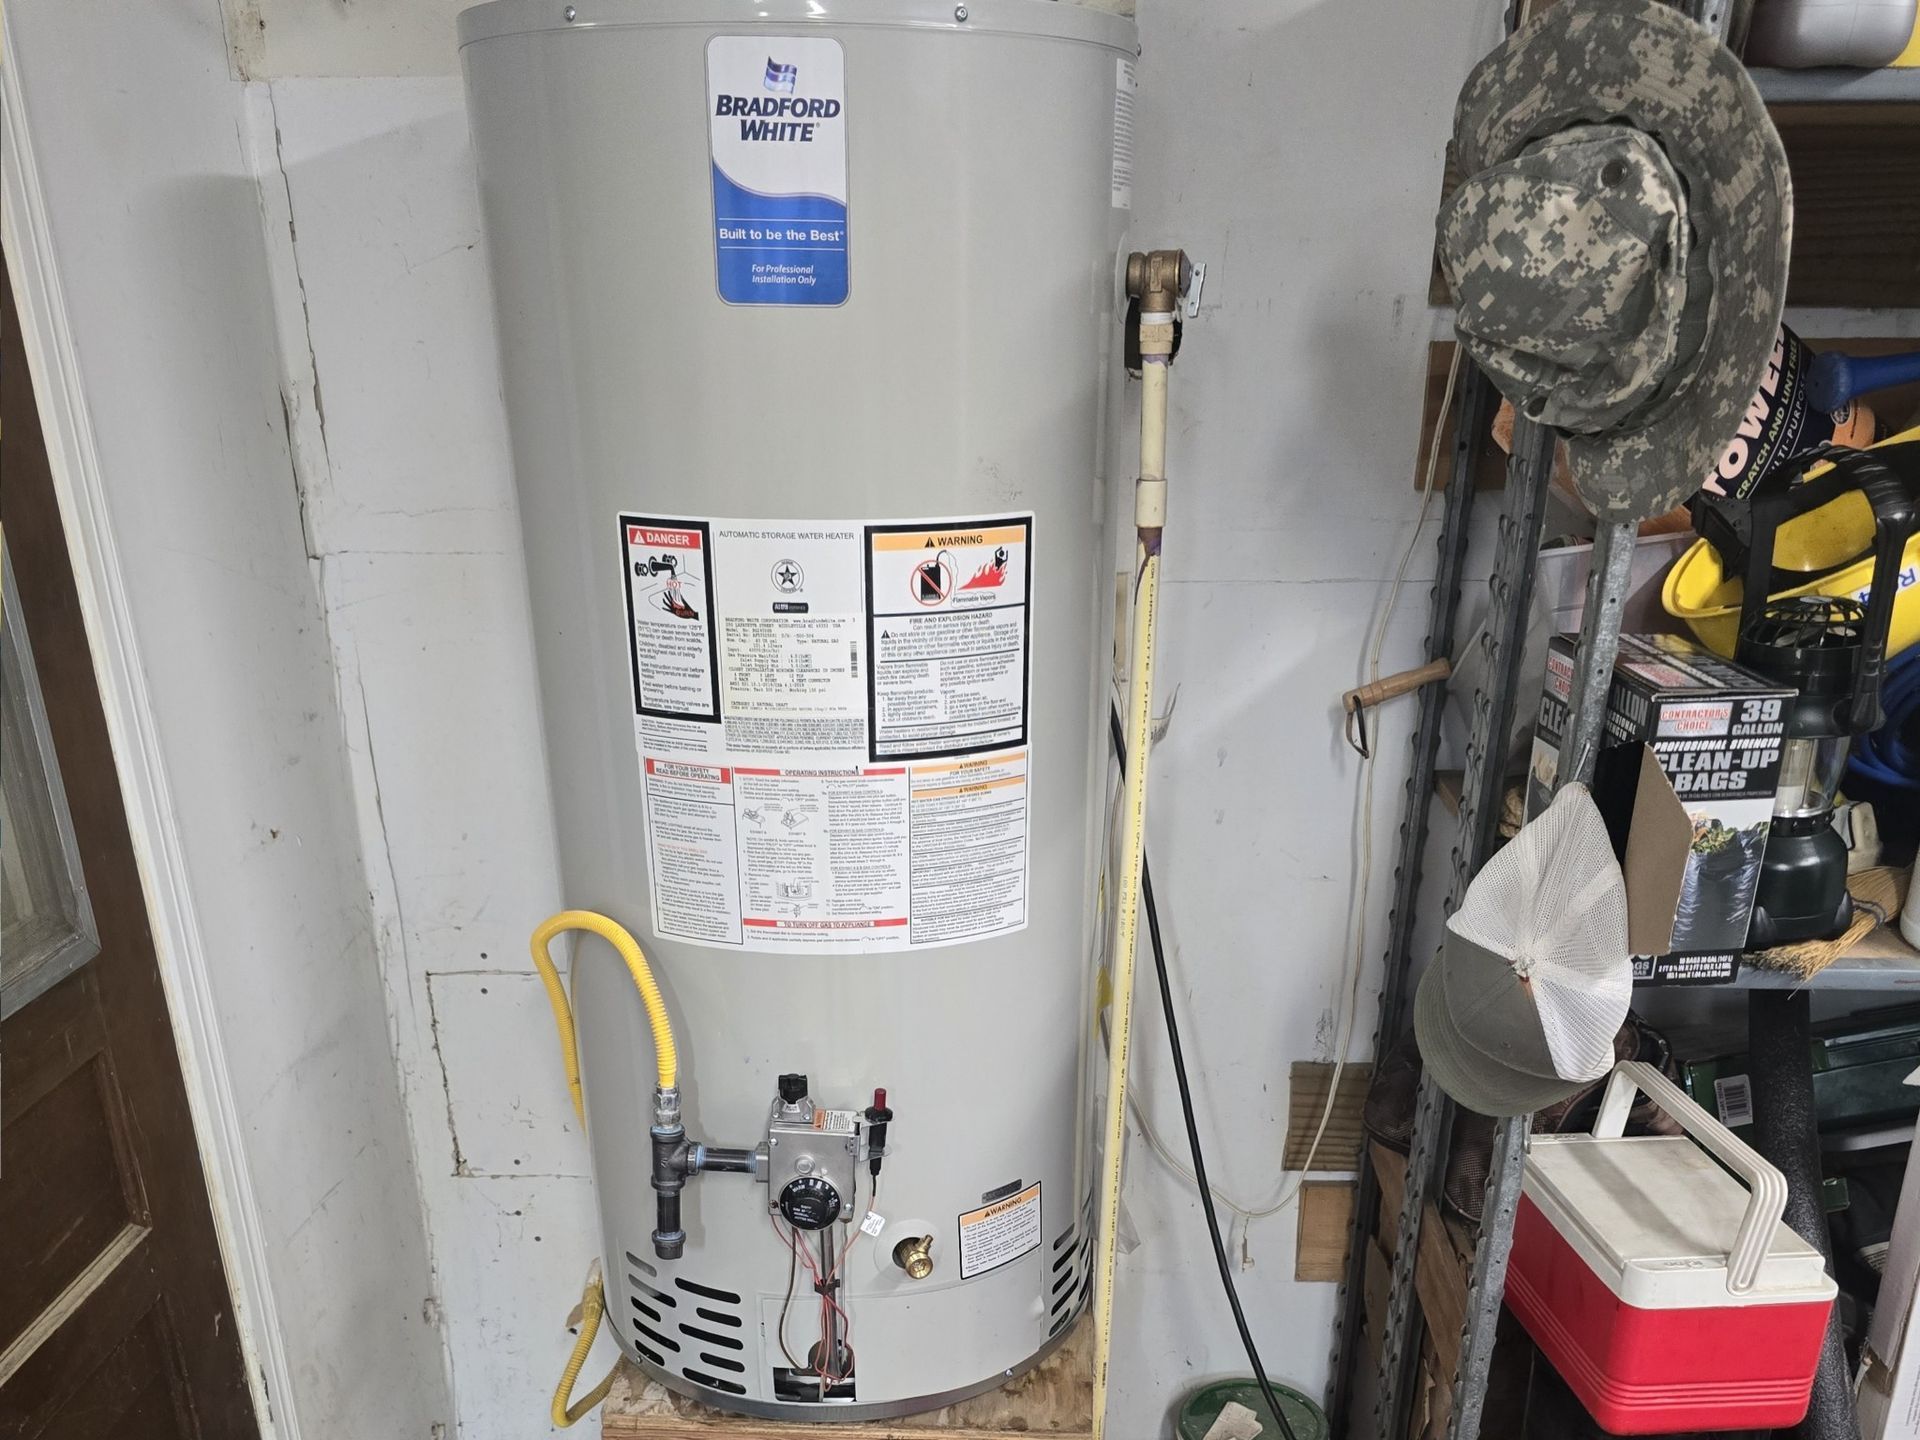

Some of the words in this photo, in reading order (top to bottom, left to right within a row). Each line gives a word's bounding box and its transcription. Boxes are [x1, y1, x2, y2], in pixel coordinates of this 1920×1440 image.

[715, 94, 841, 118] BRADFORD
[740, 119, 815, 142] WHITE
[719, 228, 746, 240] Built
[749, 229, 762, 240] to
[766, 229, 783, 241] be
[786, 229, 807, 241] the
[810, 230, 840, 242] Best
[751, 264, 765, 274] For
[766, 264, 814, 275] Professional
[751, 275, 797, 285] Installation
[797, 276, 817, 287] Only
[1787, 338, 1799, 372] FREE
[1781, 371, 1797, 406] LINT
[1701, 325, 1786, 498] TOWEL
[1768, 406, 1786, 443] AND
[1735, 442, 1771, 500] CRATCH
[646, 532, 690, 546] DANGER
[719, 530, 760, 539] AUTOMATIC
[761, 531, 797, 540] STORAGE
[798, 532, 824, 540] WATER
[825, 532, 855, 540] HEATER
[937, 535, 983, 547] WARNING
[666, 579, 683, 589] HOT
[952, 595, 979, 604] Flammable
[979, 593, 996, 602] Vapors
[650, 621, 676, 629] temperature
[938, 614, 970, 622] EXPLOSION
[1539, 695, 1565, 737] CLE
[1740, 699, 1782, 723] 39
[1661, 708, 1729, 721] CONTRACTOR'S
[1732, 723, 1784, 736] GALLON
[1676, 720, 1711, 732] CHOICE
[1653, 742, 1727, 752] PROFESSIONAL
[1729, 738, 1782, 750] STRENGTH
[964, 759, 988, 769] WARNING
[1657, 750, 1780, 773] CLEAN-UP
[670, 769, 690, 777] BEFORE
[690, 772, 719, 780] OPERATING
[1674, 771, 1748, 792] BAGS
[964, 784, 988, 793] WARNING
[784, 920, 792, 928] TO
[841, 920, 870, 928] APPLIANCE
[1634, 961, 1650, 970] GS
[989, 1196, 1022, 1215] WARNING
